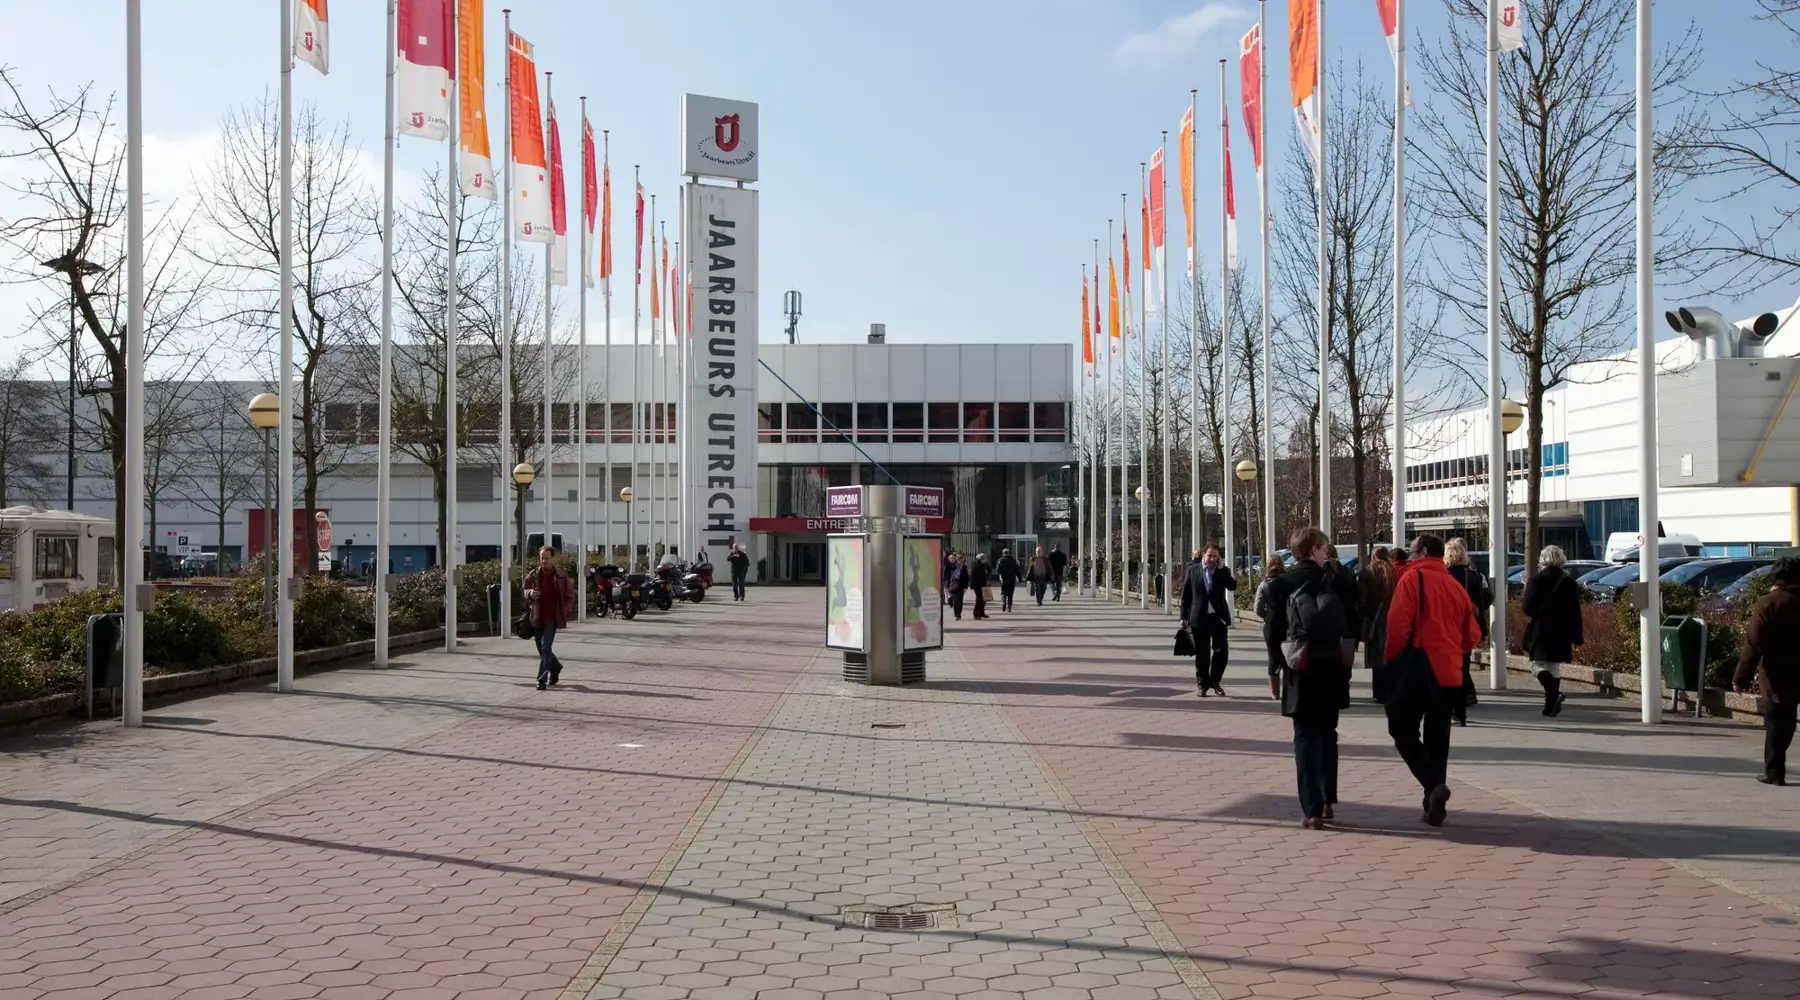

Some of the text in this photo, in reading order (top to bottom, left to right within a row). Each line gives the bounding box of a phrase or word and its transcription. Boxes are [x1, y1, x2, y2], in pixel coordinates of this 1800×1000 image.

[702, 152, 736, 165] Jaarbeurs
[708, 213, 736, 550] JAARBEURS UTRECHT
[831, 494, 858, 506] FAIRCOM
[909, 494, 939, 507] FAIRCOM
[318, 529, 331, 541] STOP
